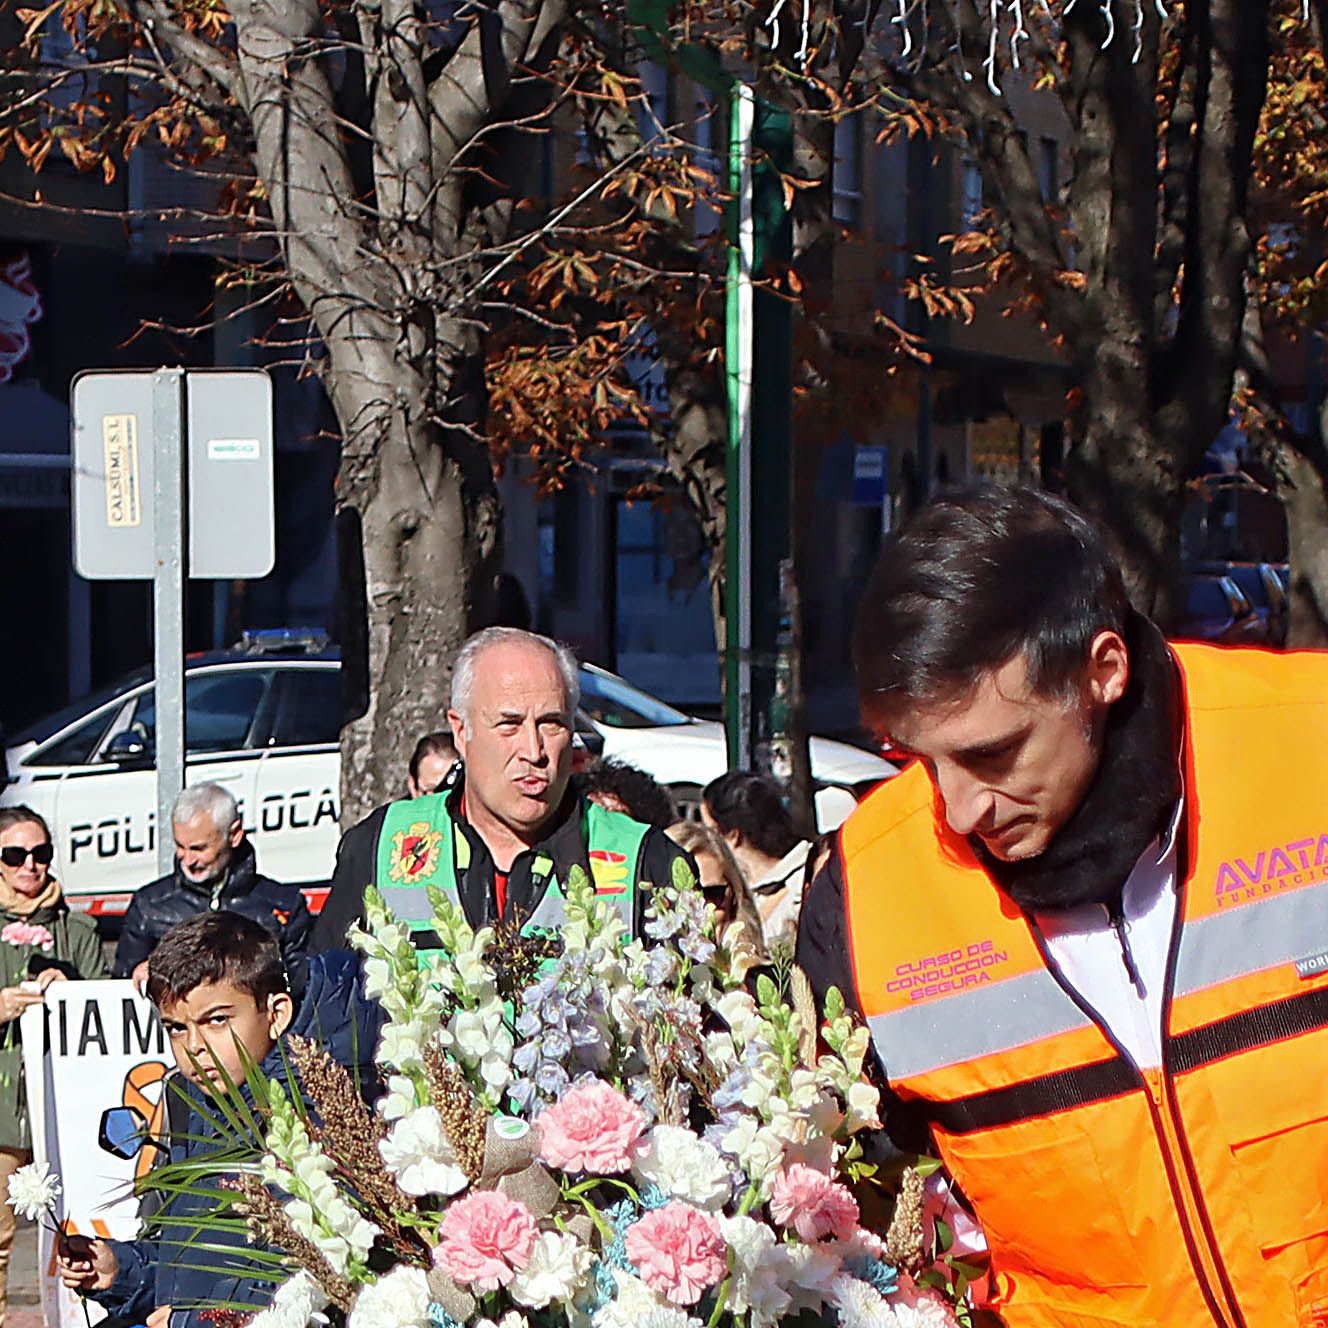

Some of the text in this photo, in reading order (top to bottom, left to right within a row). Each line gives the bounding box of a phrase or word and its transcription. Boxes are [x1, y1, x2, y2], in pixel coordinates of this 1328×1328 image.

[69, 787, 341, 863] POLI LOCA
[886, 950, 1009, 993] CONDUCCION
[895, 940, 994, 977] CURSO DE
[909, 970, 991, 1001] SEGURA
